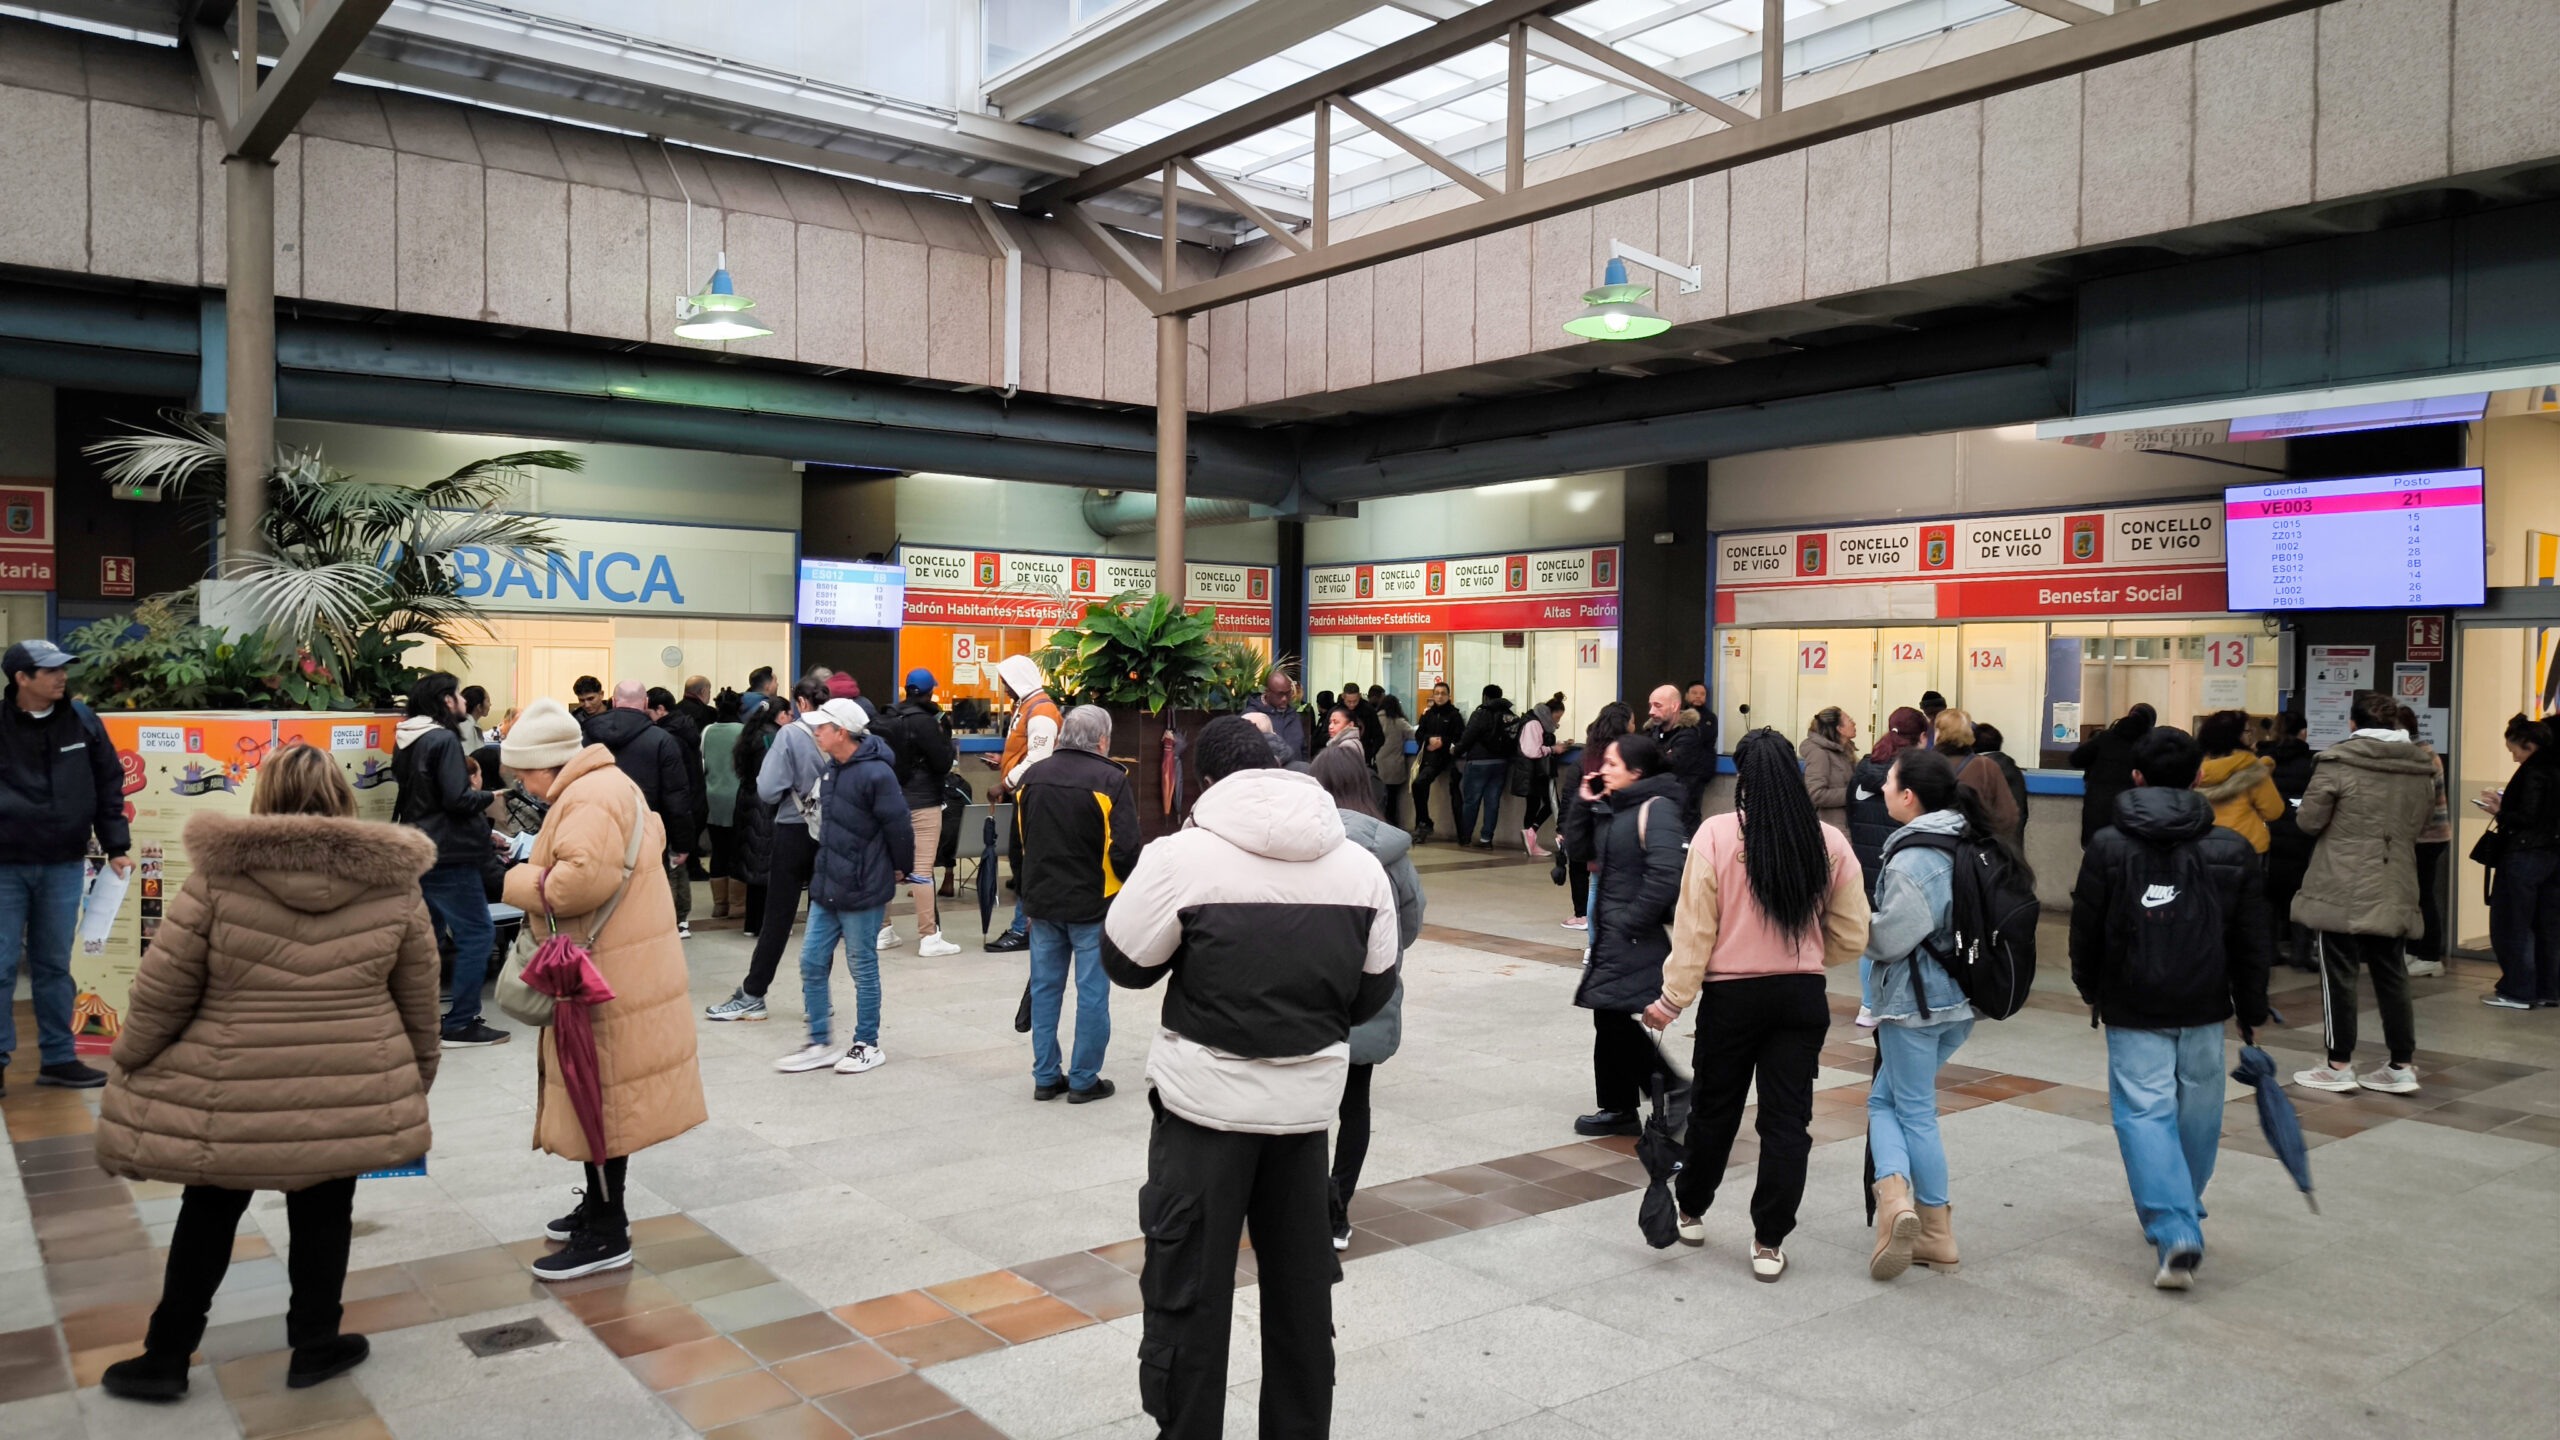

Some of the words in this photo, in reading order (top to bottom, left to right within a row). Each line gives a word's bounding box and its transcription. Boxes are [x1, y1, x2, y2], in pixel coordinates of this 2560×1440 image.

[2263, 486, 2308, 497] Quenda
[2394, 477, 2431, 487] Posto
[2260, 500, 2312, 515] VE003
[2403, 492, 2422, 506] 21
[2121, 517, 2212, 534] CONCELLO
[2272, 520, 2301, 529] CI015
[2407, 513, 2420, 522] 15
[1972, 527, 2052, 544] CONCELLO
[2272, 531, 2302, 540] ZZ013
[2408, 524, 2420, 532] 14
[1840, 536, 1909, 551] CONCELLO
[2131, 538, 2152, 551] DE
[2159, 534, 2200, 549] VIGO
[2407, 536, 2420, 545] 24
[1726, 544, 1787, 558] CONCELLO
[1981, 546, 2000, 558] DE
[2005, 544, 2042, 557] VIGO
[2271, 553, 2304, 562] PB019
[2408, 548, 2421, 556] 28
[908, 555, 966, 567] CONCELLO
[1536, 558, 1585, 571] CONCELLO
[1733, 560, 1750, 571] DE
[1752, 558, 1780, 570] VIGO
[1848, 554, 1864, 565] DE
[1868, 552, 1900, 564] VIGO
[1010, 561, 1064, 573] CONCELLO
[1108, 566, 1156, 577] CONCELLO
[1455, 564, 1500, 576] CONCELLO
[2272, 564, 2304, 573] ES012
[2407, 559, 2421, 568] 8B
[413, 544, 684, 604] BANCA
[811, 569, 844, 580] ES012
[915, 568, 929, 577] DE
[933, 568, 960, 579] VIGO
[1017, 573, 1030, 582] DE
[1033, 574, 1058, 584] VIGO
[1195, 572, 1241, 582] CONCELLO
[1314, 573, 1351, 584] CONCELLO
[1380, 569, 1420, 580] CONCELLO
[1541, 573, 1554, 583] DE
[1556, 571, 1579, 582] VIGO
[2273, 575, 2303, 584] ZZ011
[2409, 571, 2421, 579] 14
[1113, 578, 1126, 587] DE
[1129, 579, 1151, 588] VIGO
[1385, 582, 1394, 591] DE
[1397, 580, 1415, 590] VIGO
[1460, 578, 1471, 586] DE
[1473, 576, 1494, 586] VIGO
[1200, 583, 1212, 592] DE
[1214, 584, 1236, 593] VIGO
[1318, 585, 1327, 594] DE
[1329, 584, 1347, 593] VIGO
[2039, 586, 2120, 605] Benestar
[2126, 584, 2183, 602] Social
[2275, 586, 2302, 595] LI002
[2408, 582, 2421, 591] 26
[2273, 597, 2305, 606] PB018
[2409, 594, 2422, 602] 28
[902, 602, 944, 615] Padrón
[947, 603, 1078, 620] Habitantes-Estatística
[1544, 606, 1572, 618] Altas
[1579, 603, 1618, 617] Padrón
[1309, 614, 1336, 626] Padrón
[1337, 612, 1431, 625] Habitantes-Estatística
[957, 638, 971, 658] 8
[977, 648, 986, 658] B
[1580, 644, 1597, 664] 11
[1892, 643, 1924, 660] 12A
[2208, 640, 2244, 668] 13
[1425, 648, 1441, 667] 10
[1801, 646, 1826, 668] 12
[1970, 650, 2003, 668] 13A
[141, 731, 180, 740] CONCELLO
[158, 740, 176, 748] VIGO
[2146, 884, 2175, 899] NIKE
